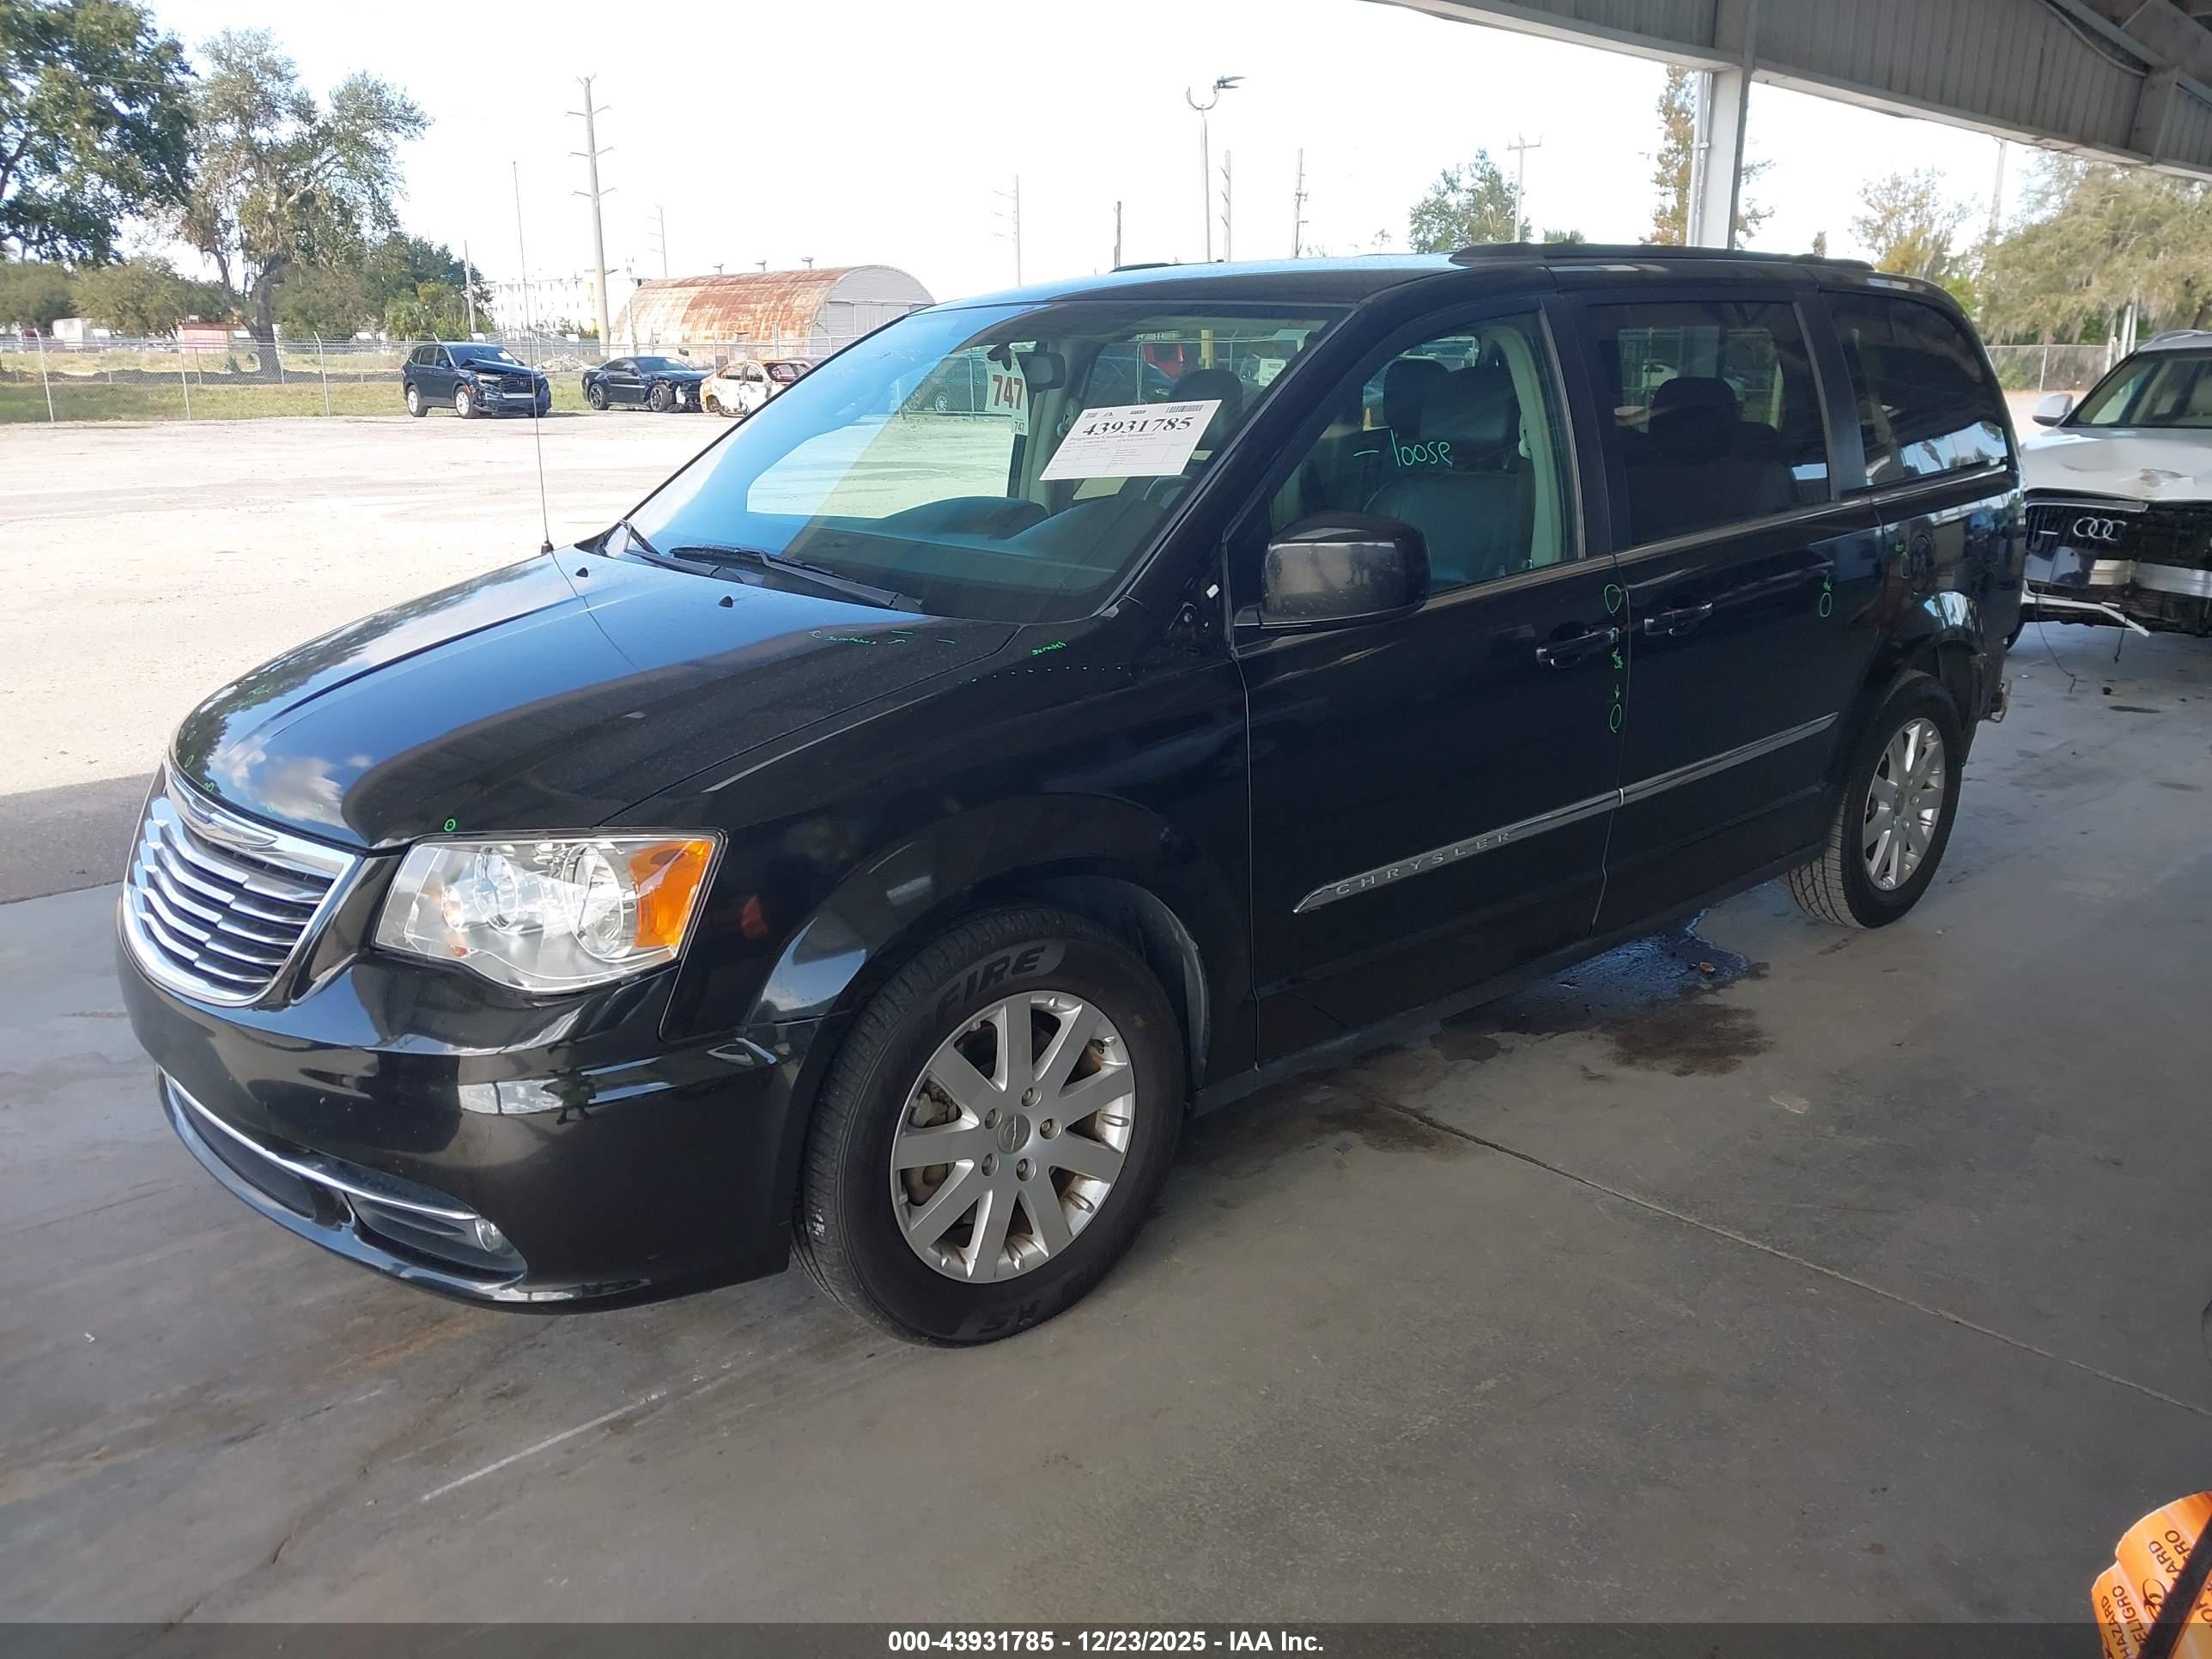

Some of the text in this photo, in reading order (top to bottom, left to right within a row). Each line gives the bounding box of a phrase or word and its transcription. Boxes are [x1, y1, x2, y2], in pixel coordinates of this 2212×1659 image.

[993, 374, 1024, 410] 747
[1014, 421, 1024, 433] 747
[1083, 416, 1194, 435] 43931785
[1389, 428, 1454, 467] loose
[1335, 831, 1510, 896] CHRYSLER
[2112, 1585, 2150, 1644] ELIGRO
